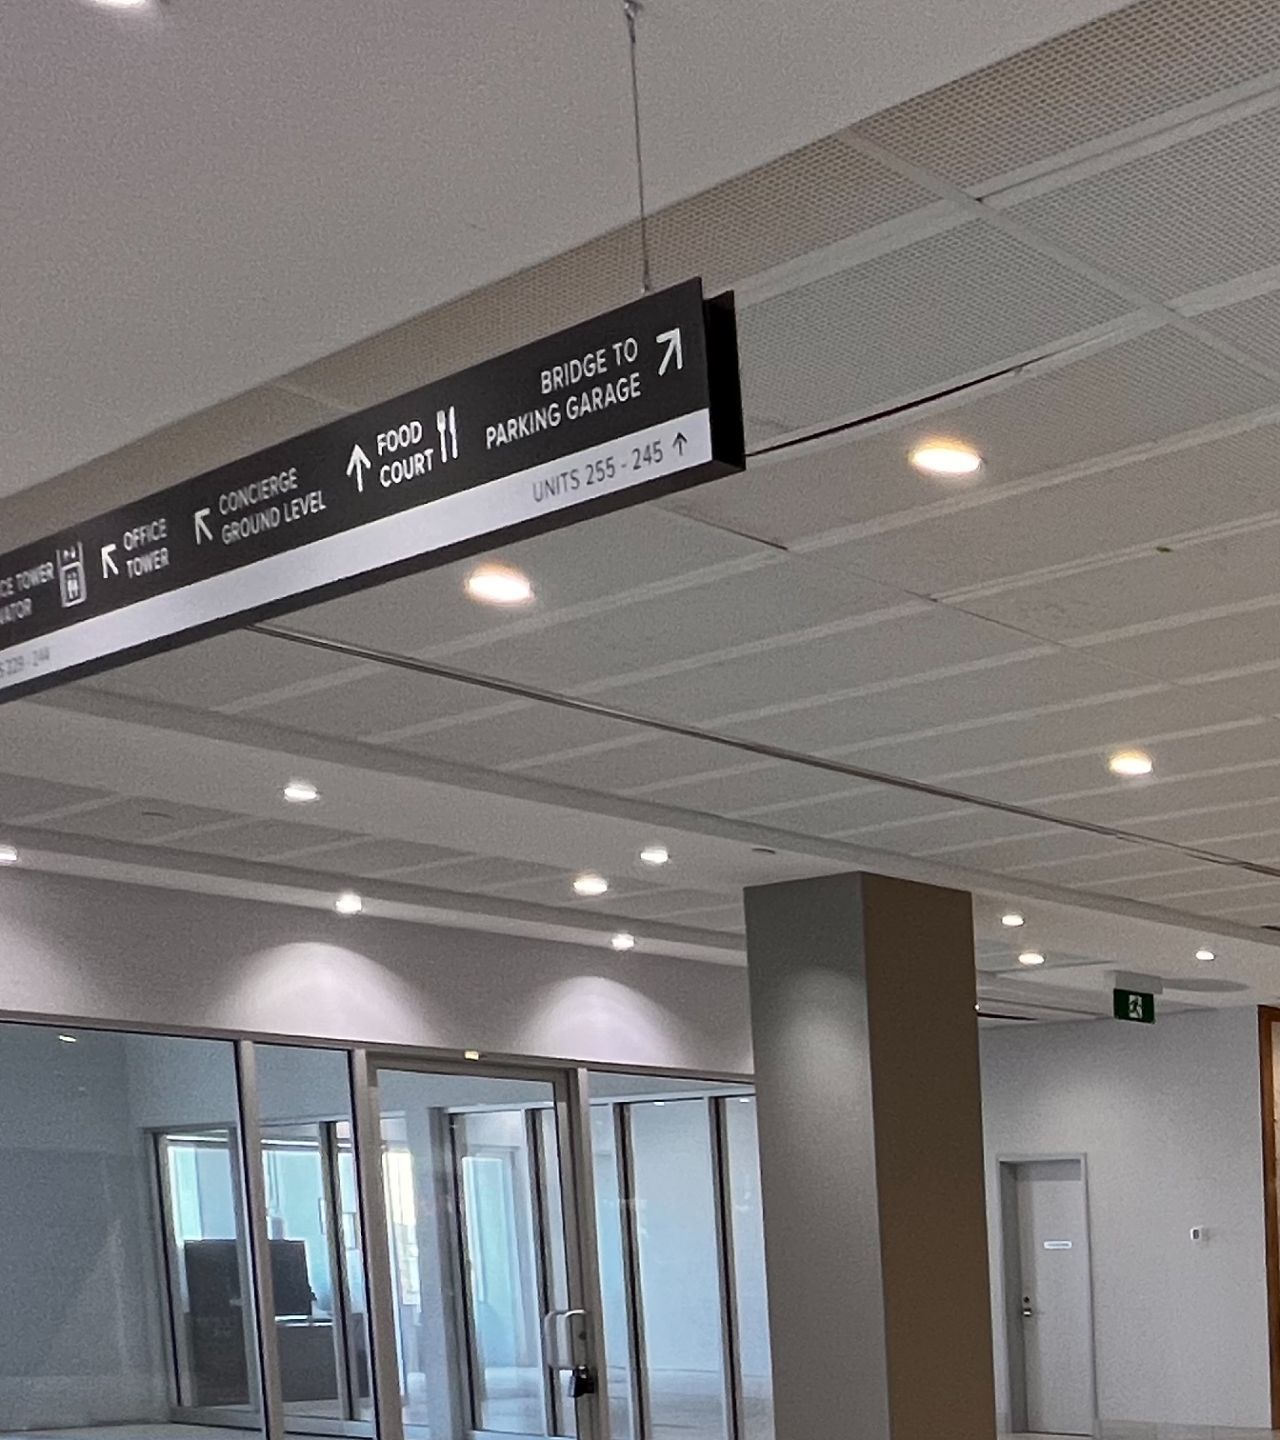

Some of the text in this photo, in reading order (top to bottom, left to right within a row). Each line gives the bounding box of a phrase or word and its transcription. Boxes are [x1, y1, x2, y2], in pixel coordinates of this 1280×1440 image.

[540, 337, 638, 394] BRIDGE TO
[485, 372, 641, 449] PARKING GARAGE
[376, 420, 423, 456] FOOD
[379, 448, 434, 487] COURT
[532, 469, 580, 502] UNITS
[586, 457, 615, 486] 255
[632, 441, 664, 470] 245
[218, 467, 298, 515] CONCIERGE
[123, 518, 167, 551] OFFICE
[221, 490, 327, 545] GROUND LEVEL
[16, 561, 55, 592] TOWER
[126, 547, 170, 579] TOWER
